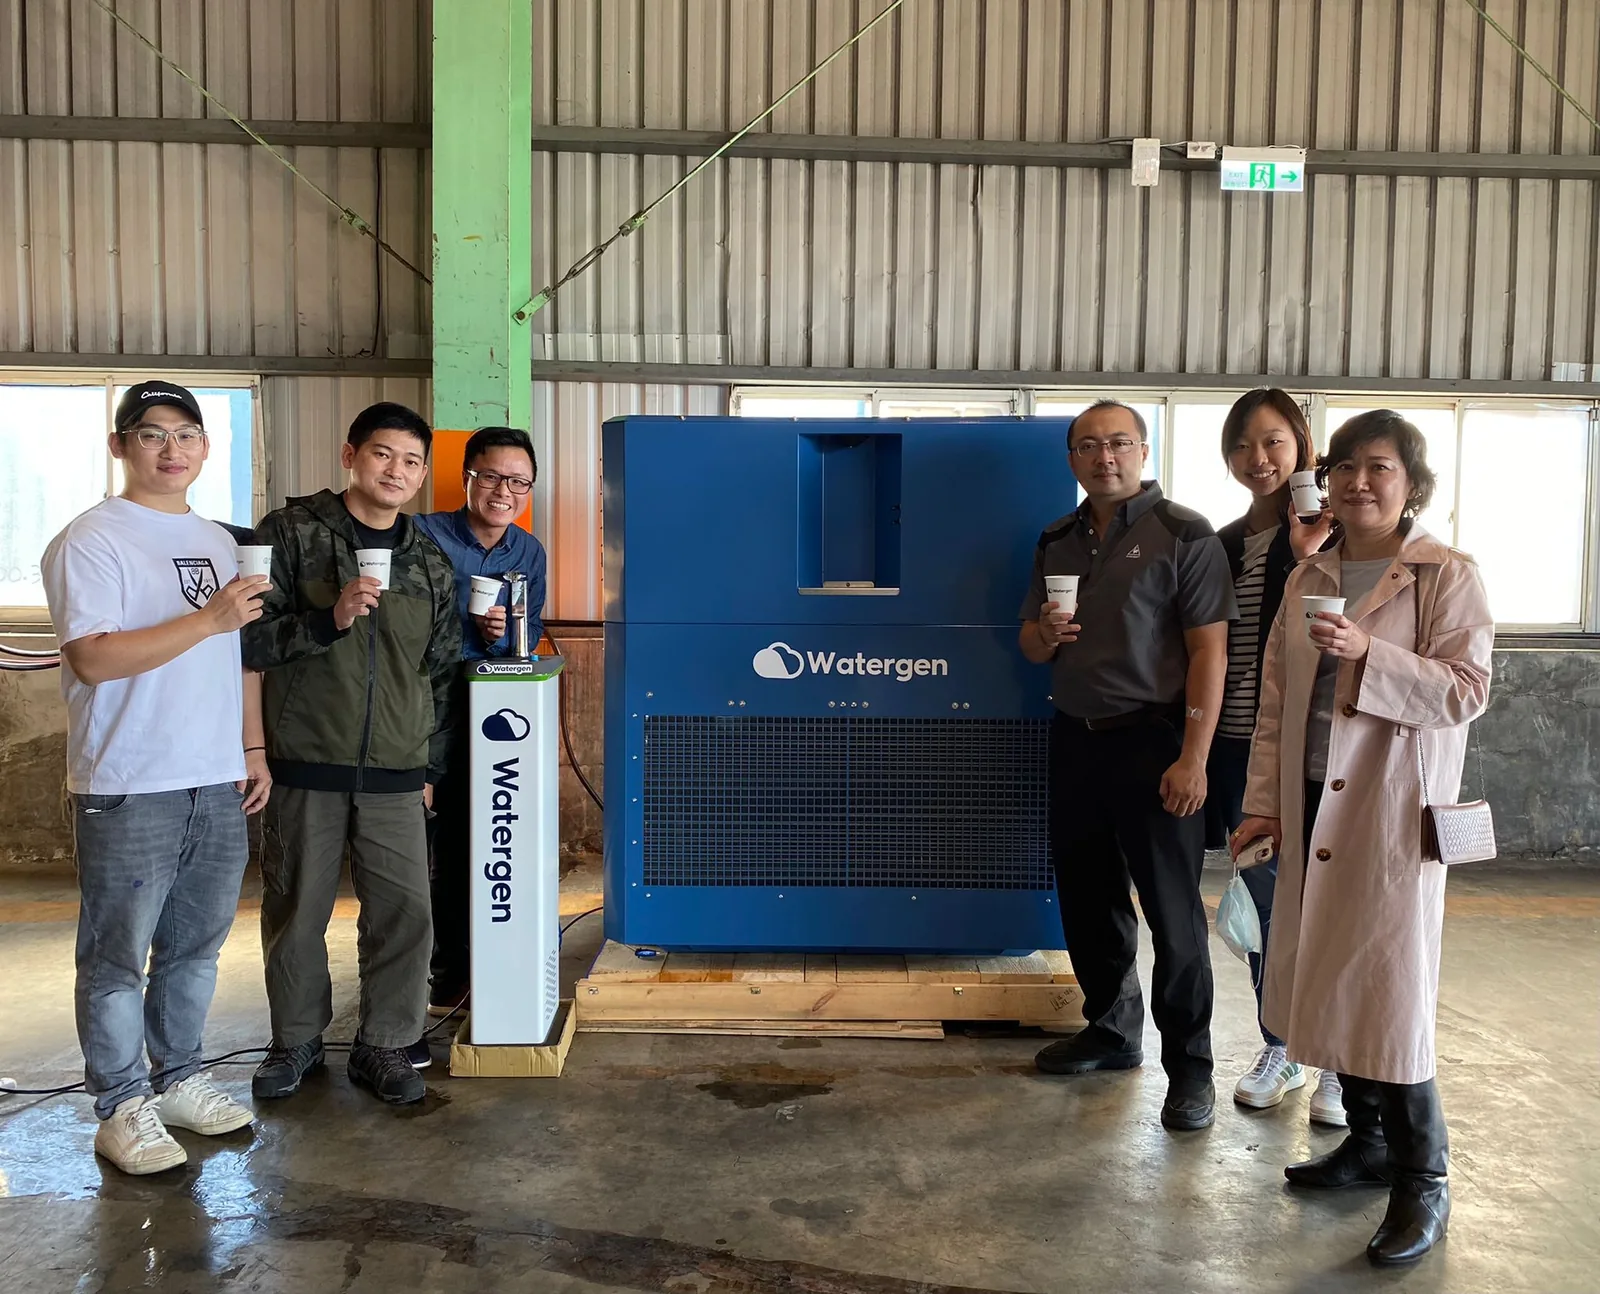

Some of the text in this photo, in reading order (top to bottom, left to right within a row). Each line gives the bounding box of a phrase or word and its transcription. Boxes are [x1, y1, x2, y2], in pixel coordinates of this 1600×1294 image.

[141, 391, 182, 399] California
[493, 665, 531, 673] Watergen
[806, 651, 948, 682] Watergen
[484, 757, 519, 923] Watergen
